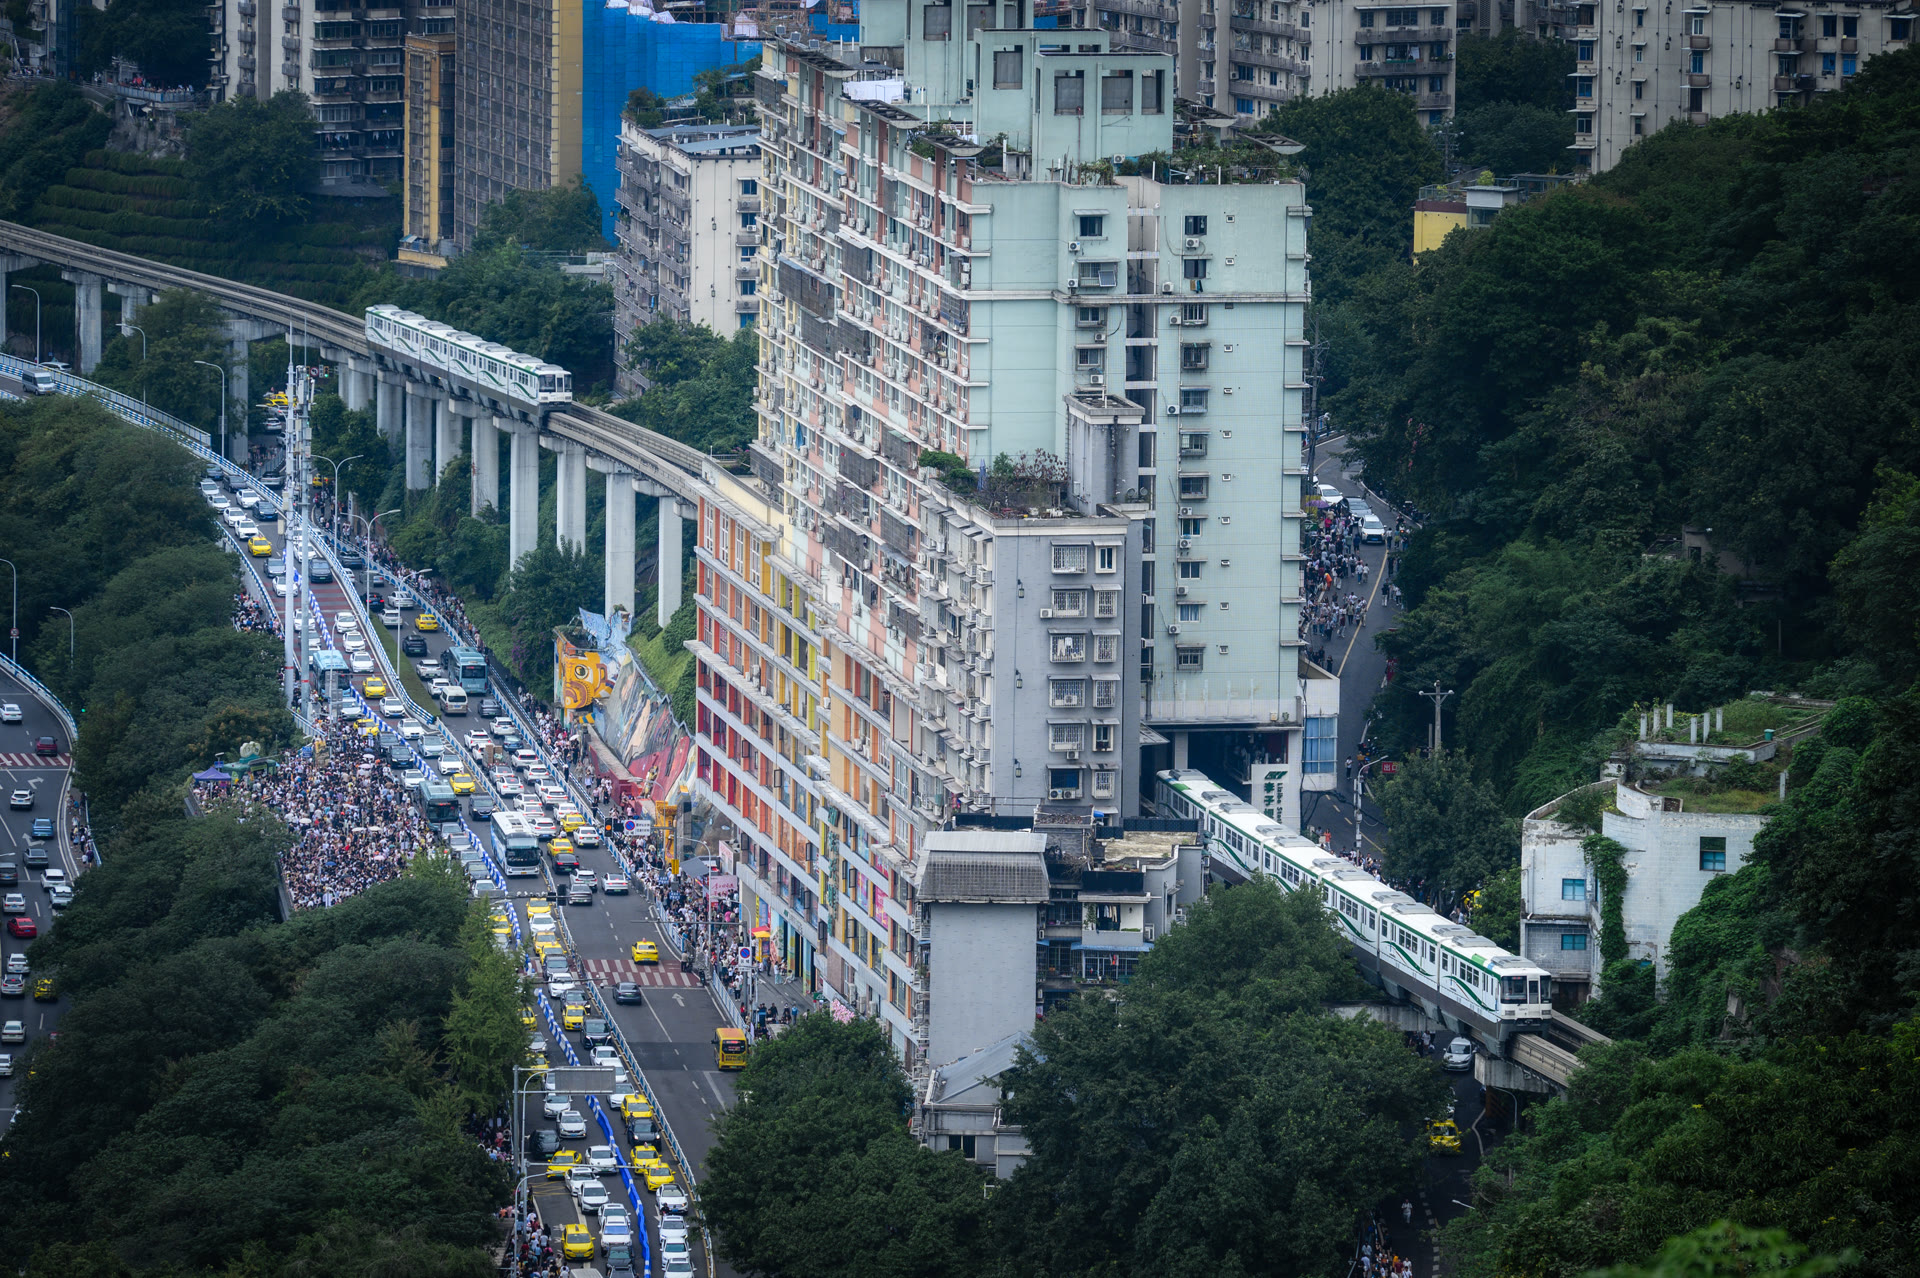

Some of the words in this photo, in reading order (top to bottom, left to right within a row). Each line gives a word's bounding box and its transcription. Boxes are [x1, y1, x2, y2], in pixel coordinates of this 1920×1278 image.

[1384, 763, 1398, 772] 出口
[1264, 781, 1275, 819] 李子坝
